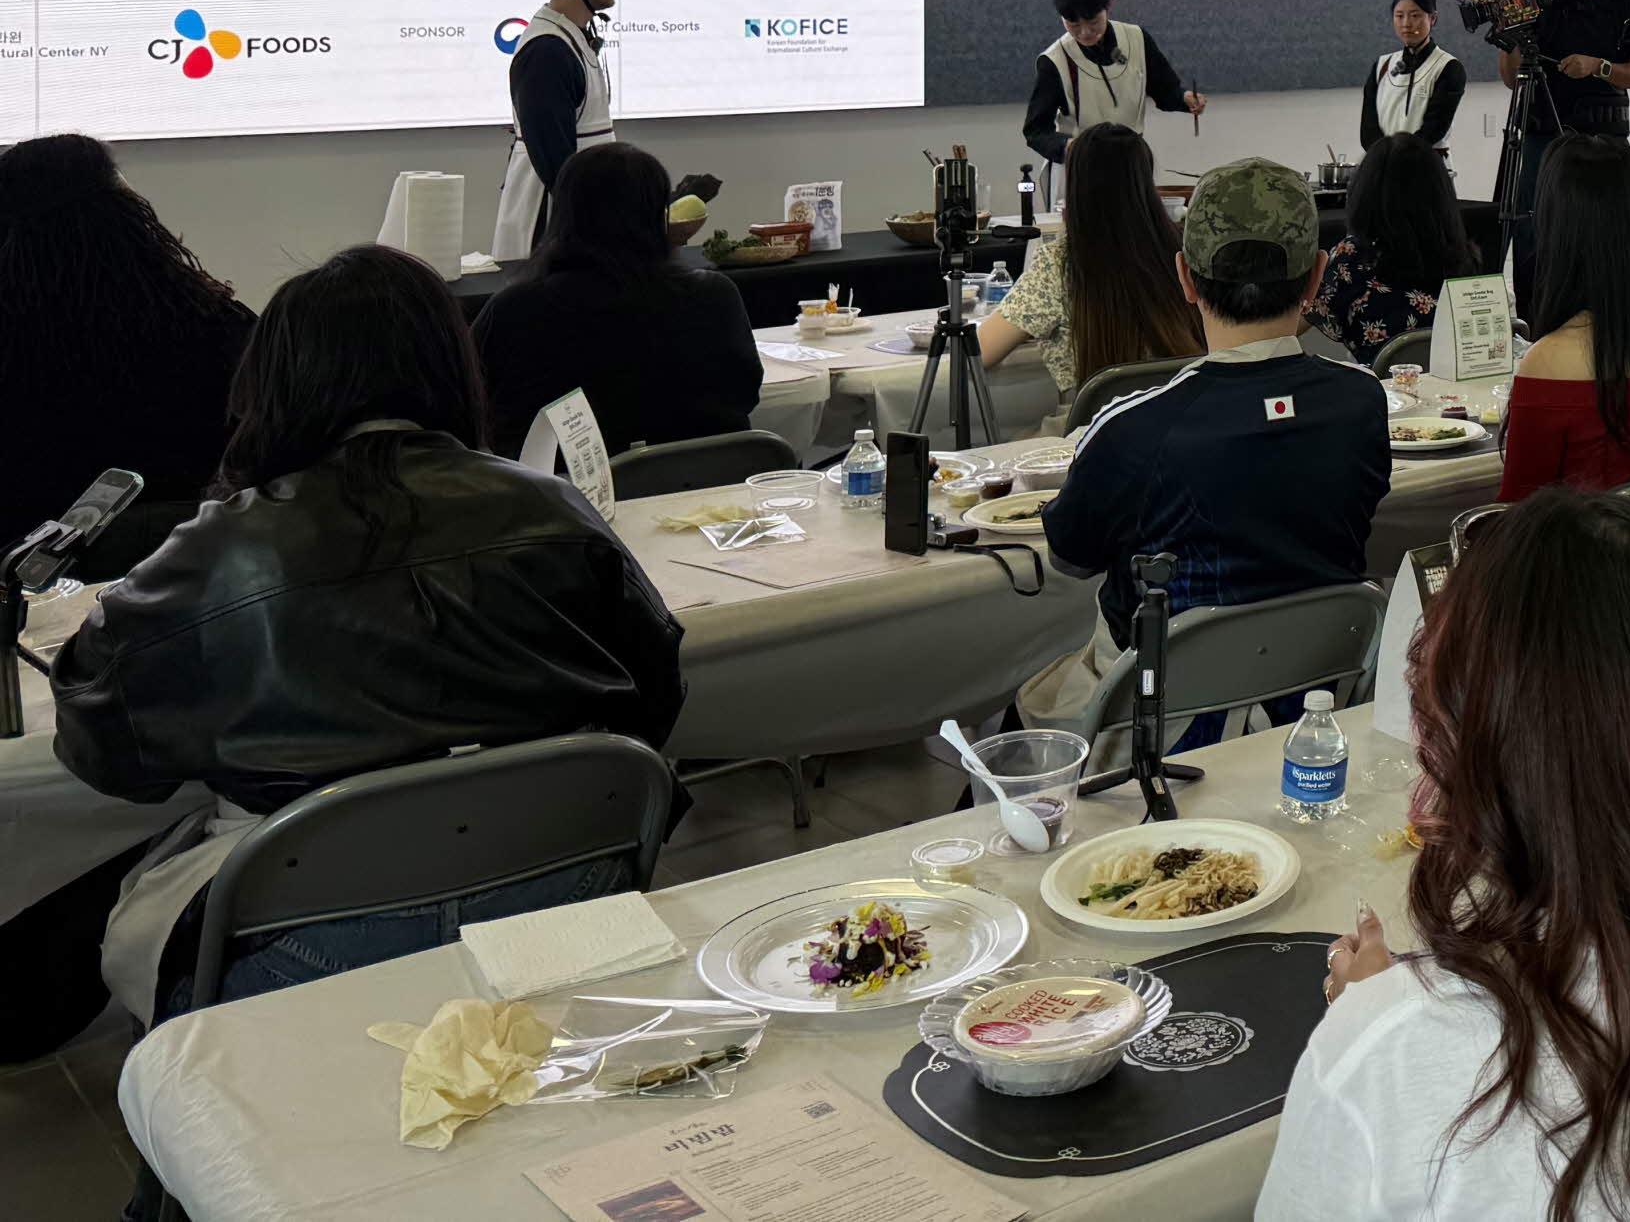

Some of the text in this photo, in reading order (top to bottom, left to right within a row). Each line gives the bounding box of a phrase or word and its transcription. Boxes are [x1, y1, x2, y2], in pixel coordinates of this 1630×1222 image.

[400, 26, 465, 38] SPONSOR
[612, 21, 659, 33] Culture,
[662, 21, 700, 32] Sports
[767, 18, 848, 36] KOFICE
[39, 46, 85, 58] Center
[90, 45, 109, 56] NY
[147, 36, 332, 64] CJ FOODS
[1293, 768, 1336, 781] Sparkletts
[1004, 990, 1048, 1021] COOKED
[1017, 995, 1062, 1025] WHITE
[664, 1123, 736, 1152] 비빔밥
